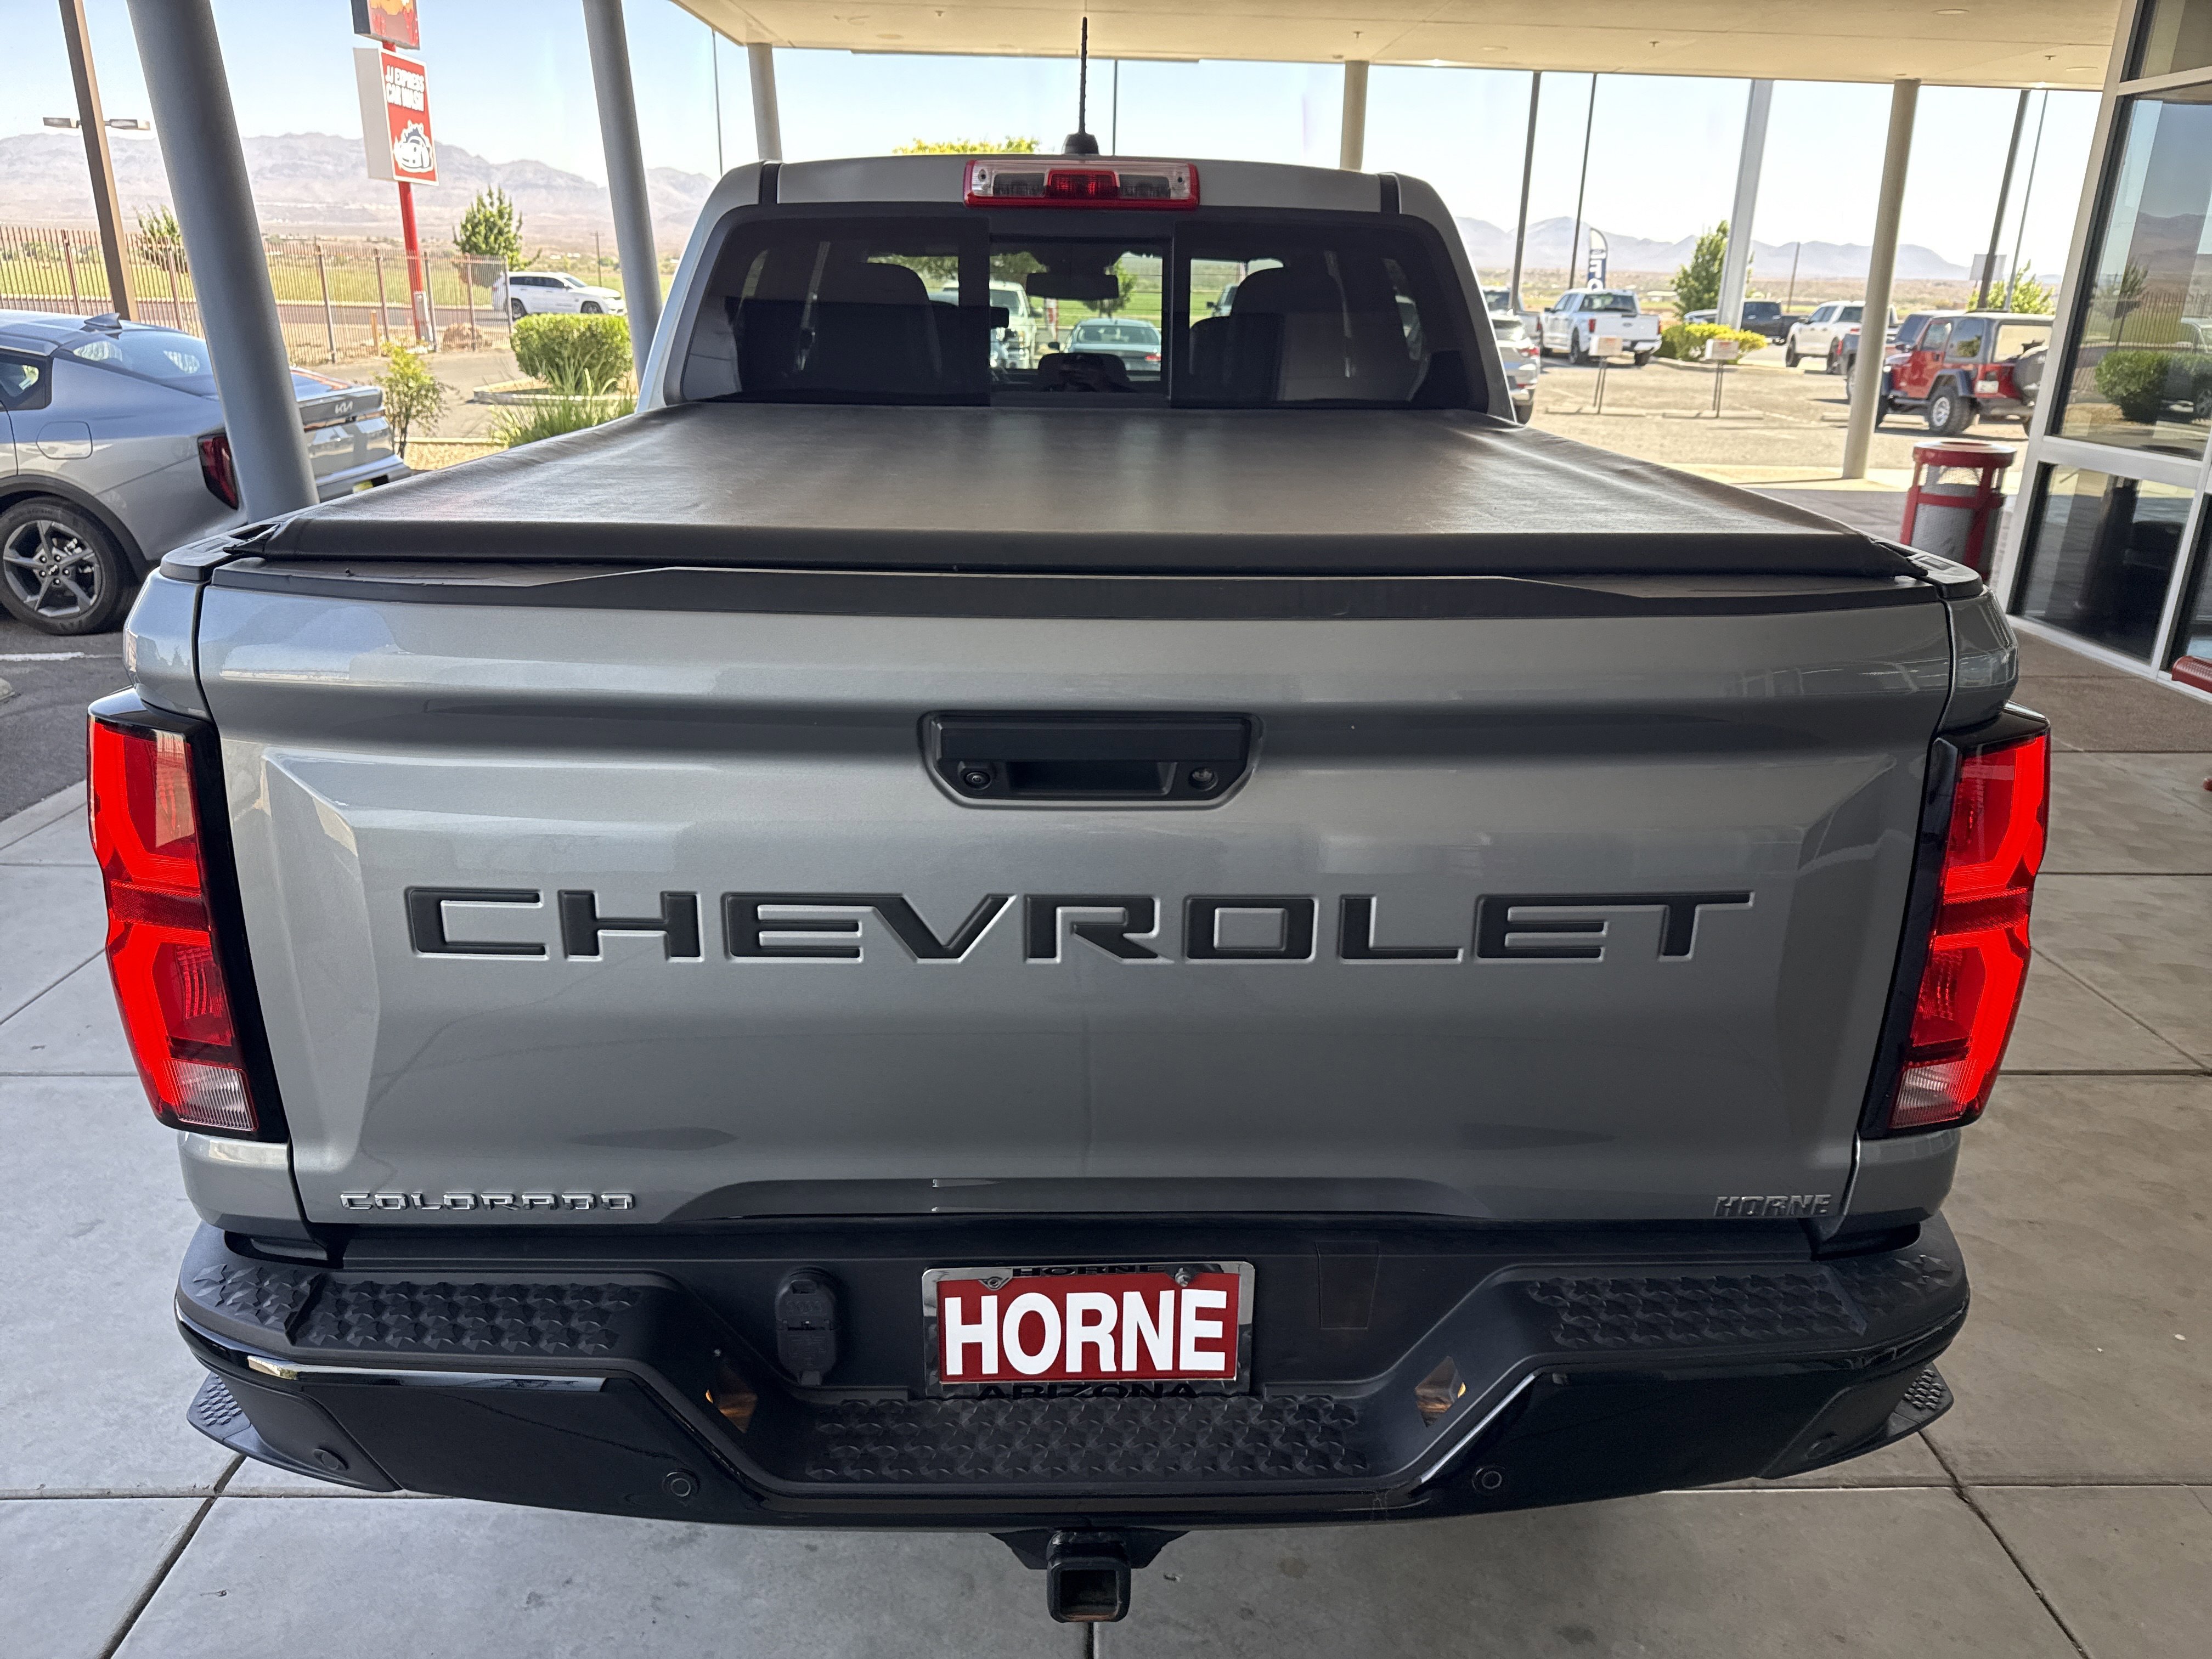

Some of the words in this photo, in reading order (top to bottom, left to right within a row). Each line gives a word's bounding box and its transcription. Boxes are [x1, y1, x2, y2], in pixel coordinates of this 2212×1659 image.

[385, 65, 394, 83] JJ
[394, 67, 425, 93] EXPRESS
[386, 82, 402, 106] CAR
[402, 87, 424, 112] WASH
[404, 885, 1756, 963] CHEVROLET
[340, 1192, 635, 1211] COLORADO
[1714, 1194, 1832, 1218] HORNE
[1013, 1266, 1166, 1277] HORNE
[944, 1289, 1227, 1376] HORNE
[977, 1382, 1200, 1400] ARIZONA
